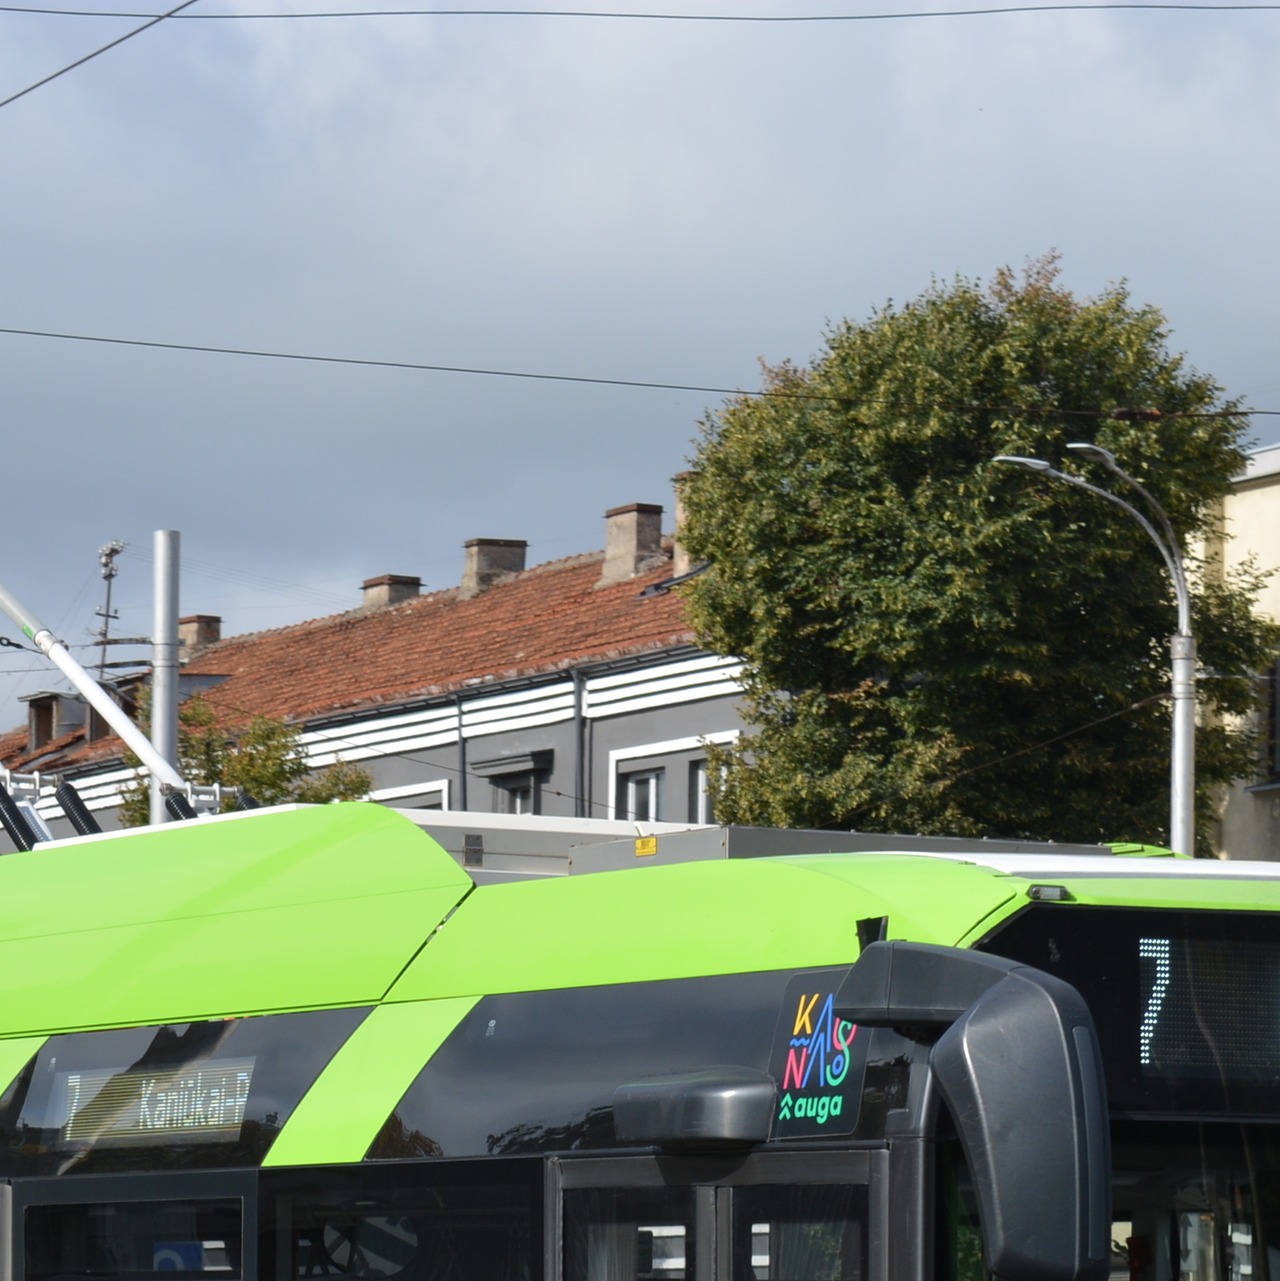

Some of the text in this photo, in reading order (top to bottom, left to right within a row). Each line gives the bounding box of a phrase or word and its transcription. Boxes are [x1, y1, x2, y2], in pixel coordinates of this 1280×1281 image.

[1138, 937, 1171, 1064] 7
[64, 1075, 81, 1141] 7
[794, 1095, 843, 1125] auga
